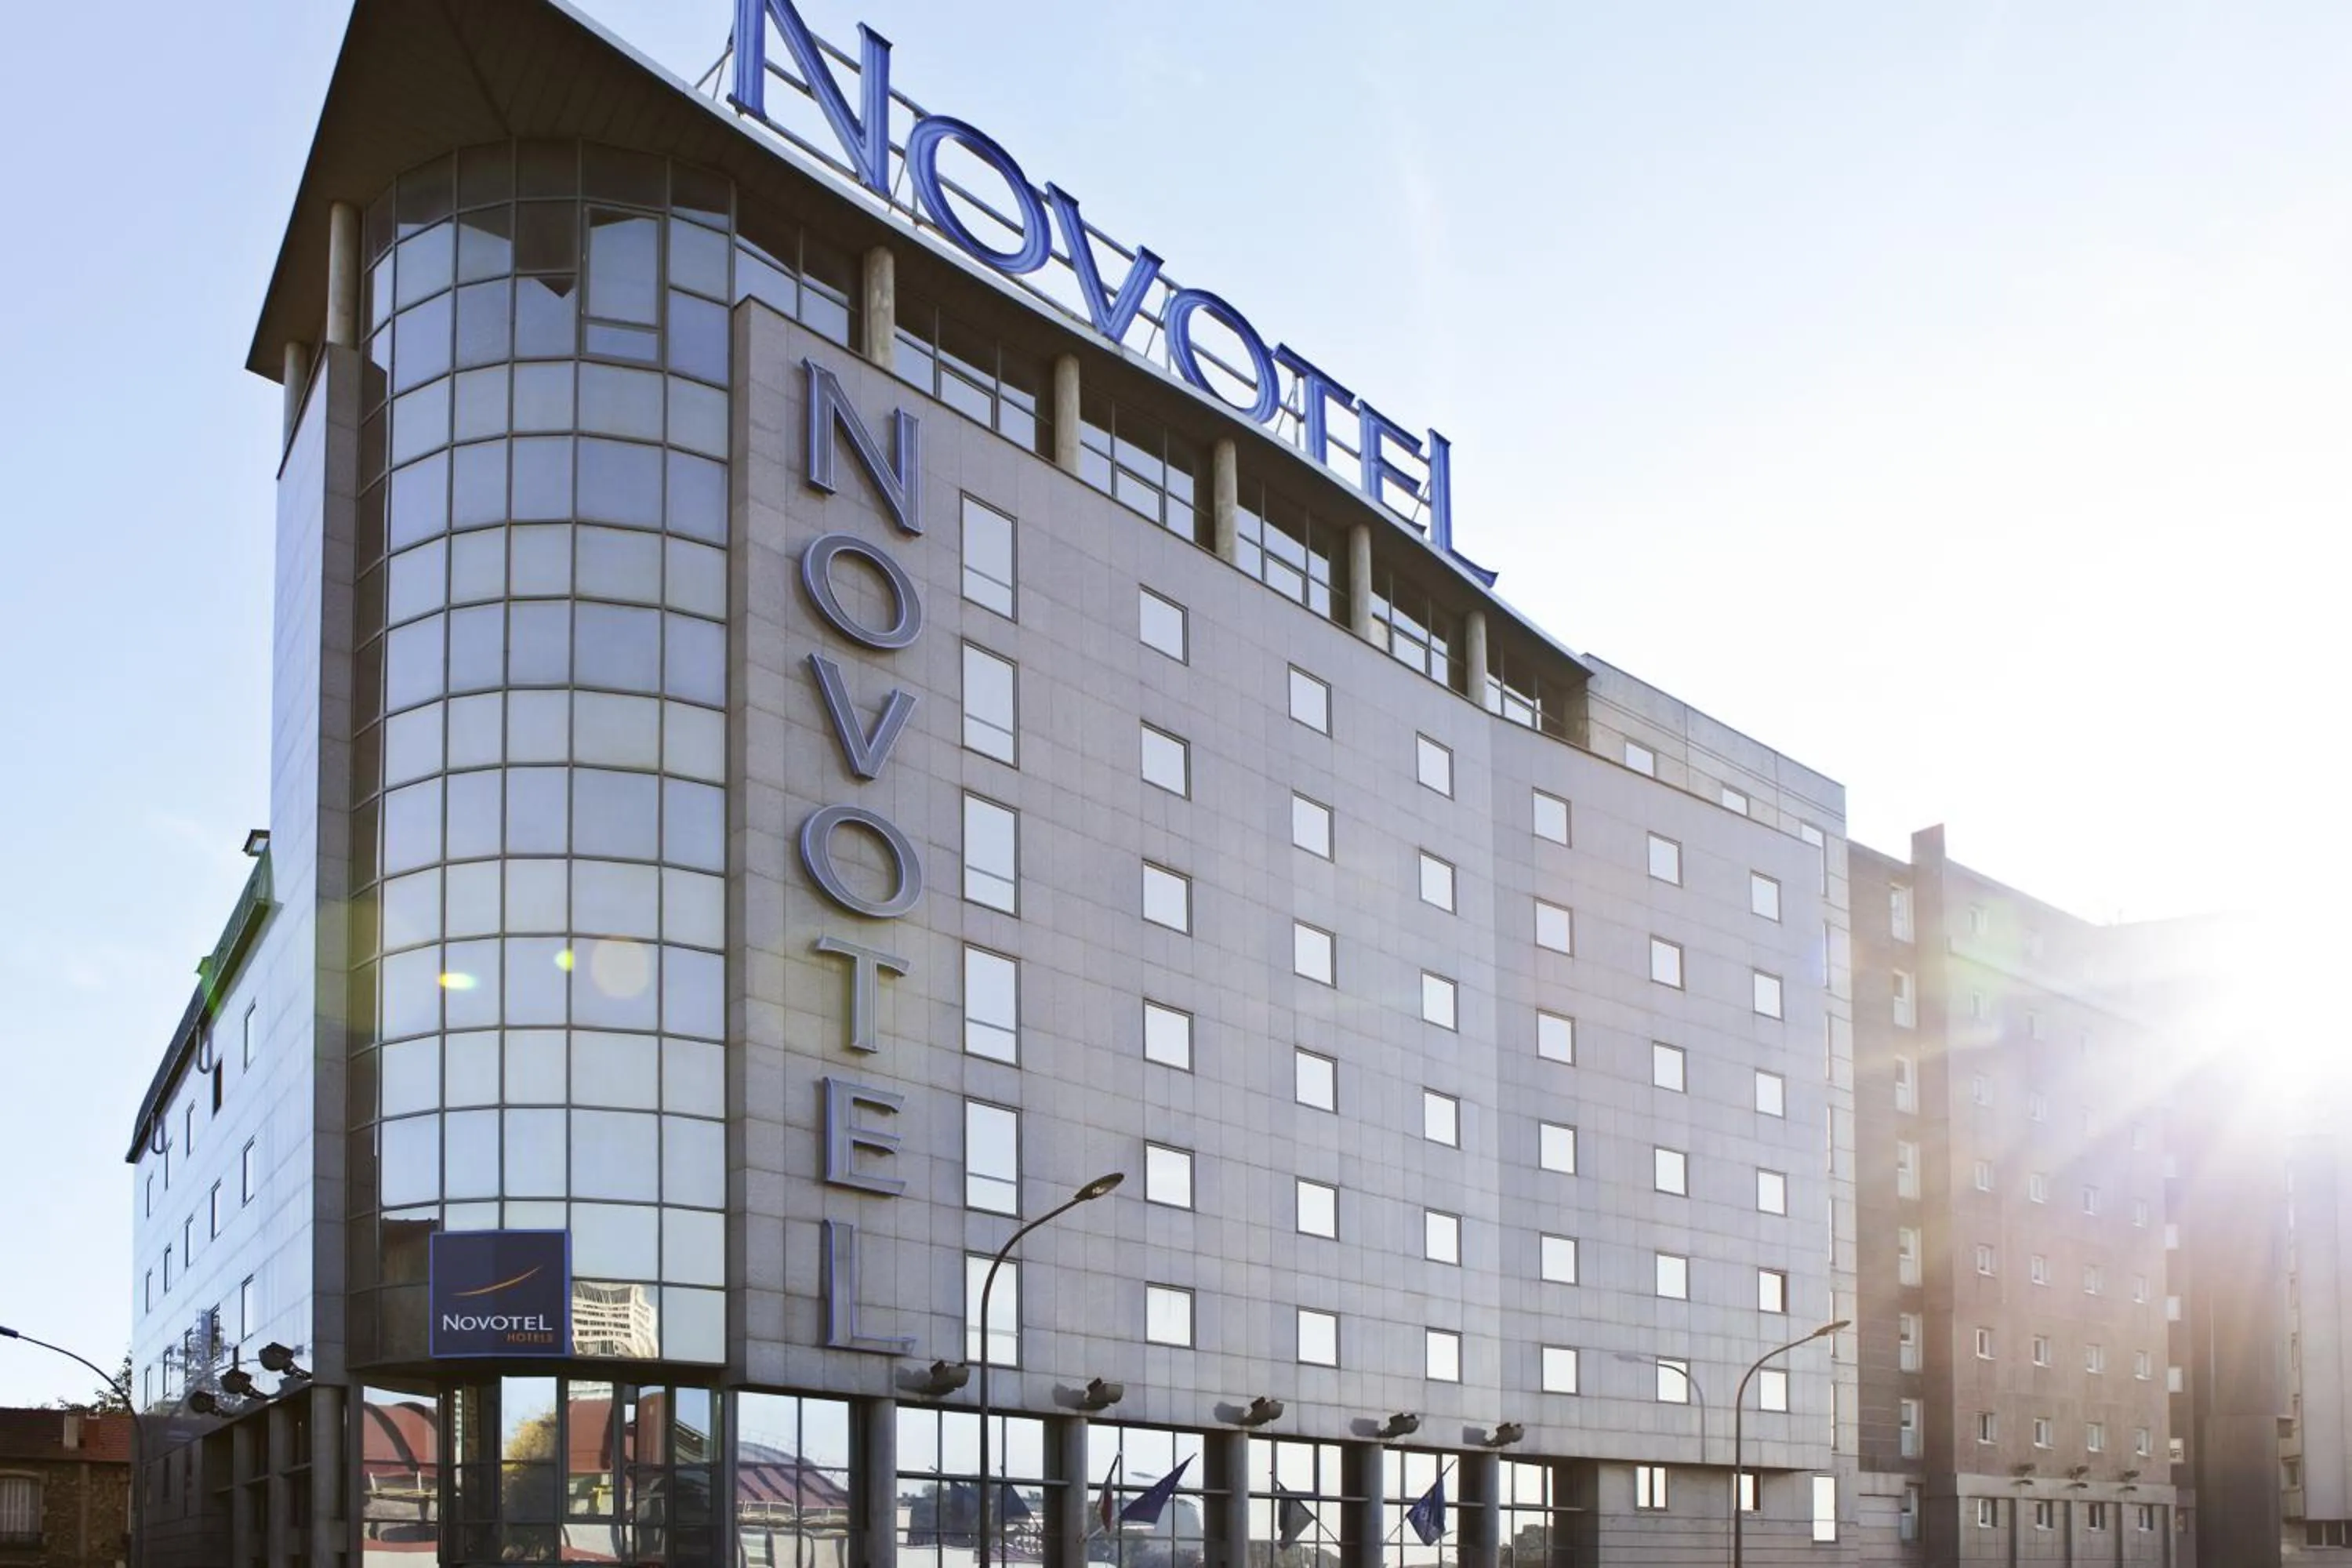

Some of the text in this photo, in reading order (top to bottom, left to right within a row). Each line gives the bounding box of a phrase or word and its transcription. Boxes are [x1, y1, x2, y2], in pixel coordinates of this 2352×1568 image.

[728, 0, 1498, 587] NOVOTEL
[801, 357, 923, 1356] NOVOTEL
[443, 1314, 553, 1330] NOVOTEL
[507, 1333, 553, 1343] HOTELS
